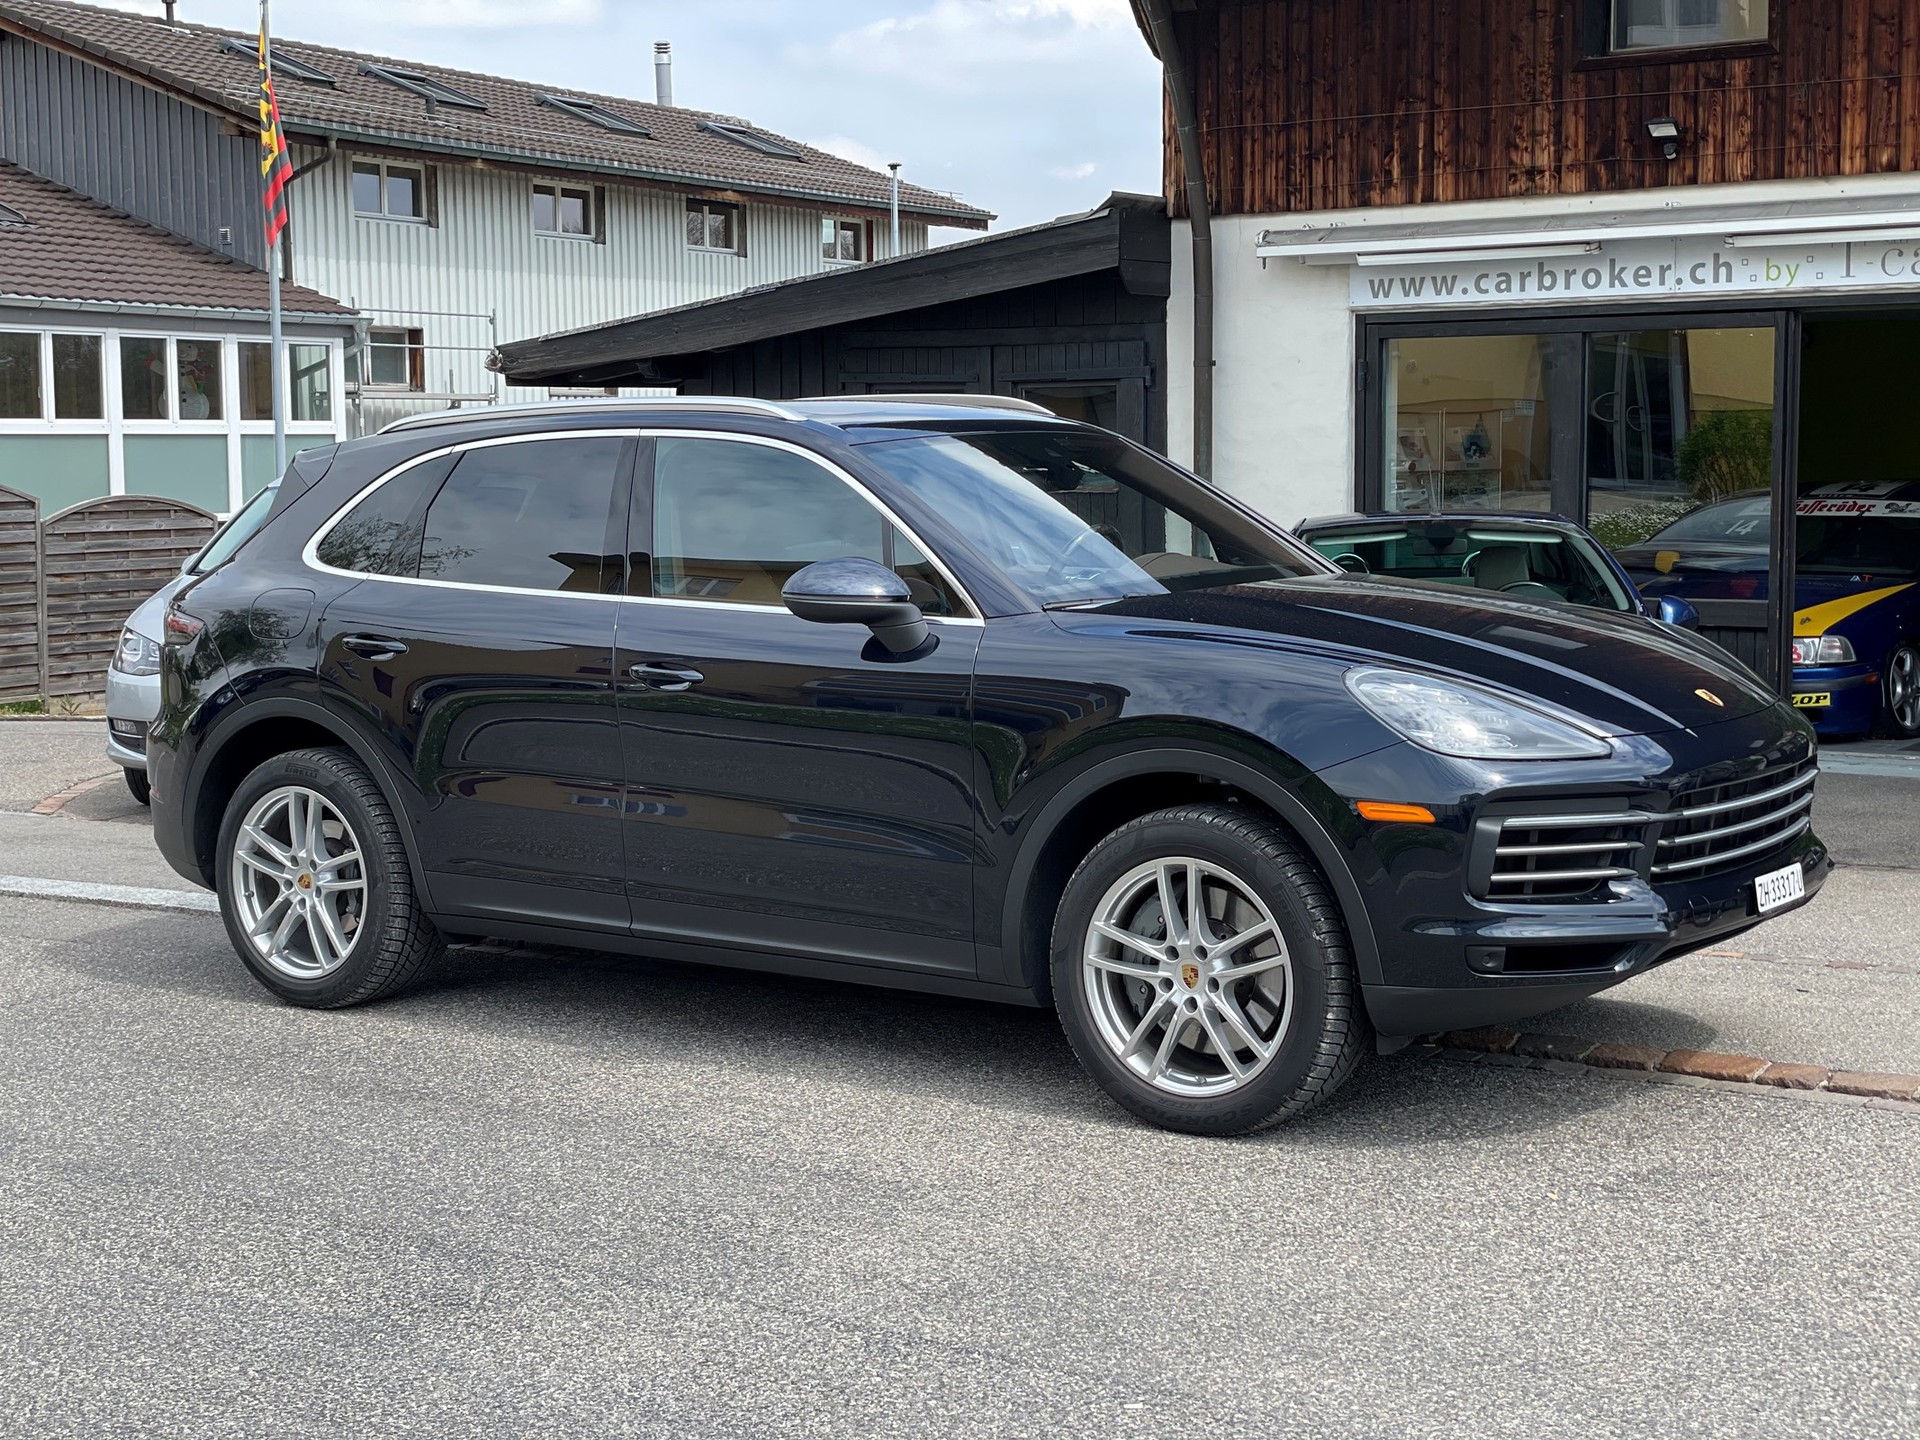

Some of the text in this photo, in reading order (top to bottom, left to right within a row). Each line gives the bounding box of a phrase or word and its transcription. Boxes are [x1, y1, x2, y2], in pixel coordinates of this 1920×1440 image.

[1368, 252, 1734, 300] www.carbroker.ch
[1765, 257, 1800, 287] by
[1725, 519, 1760, 535] 14
[1121, 1093, 1255, 1127] SCORPION
